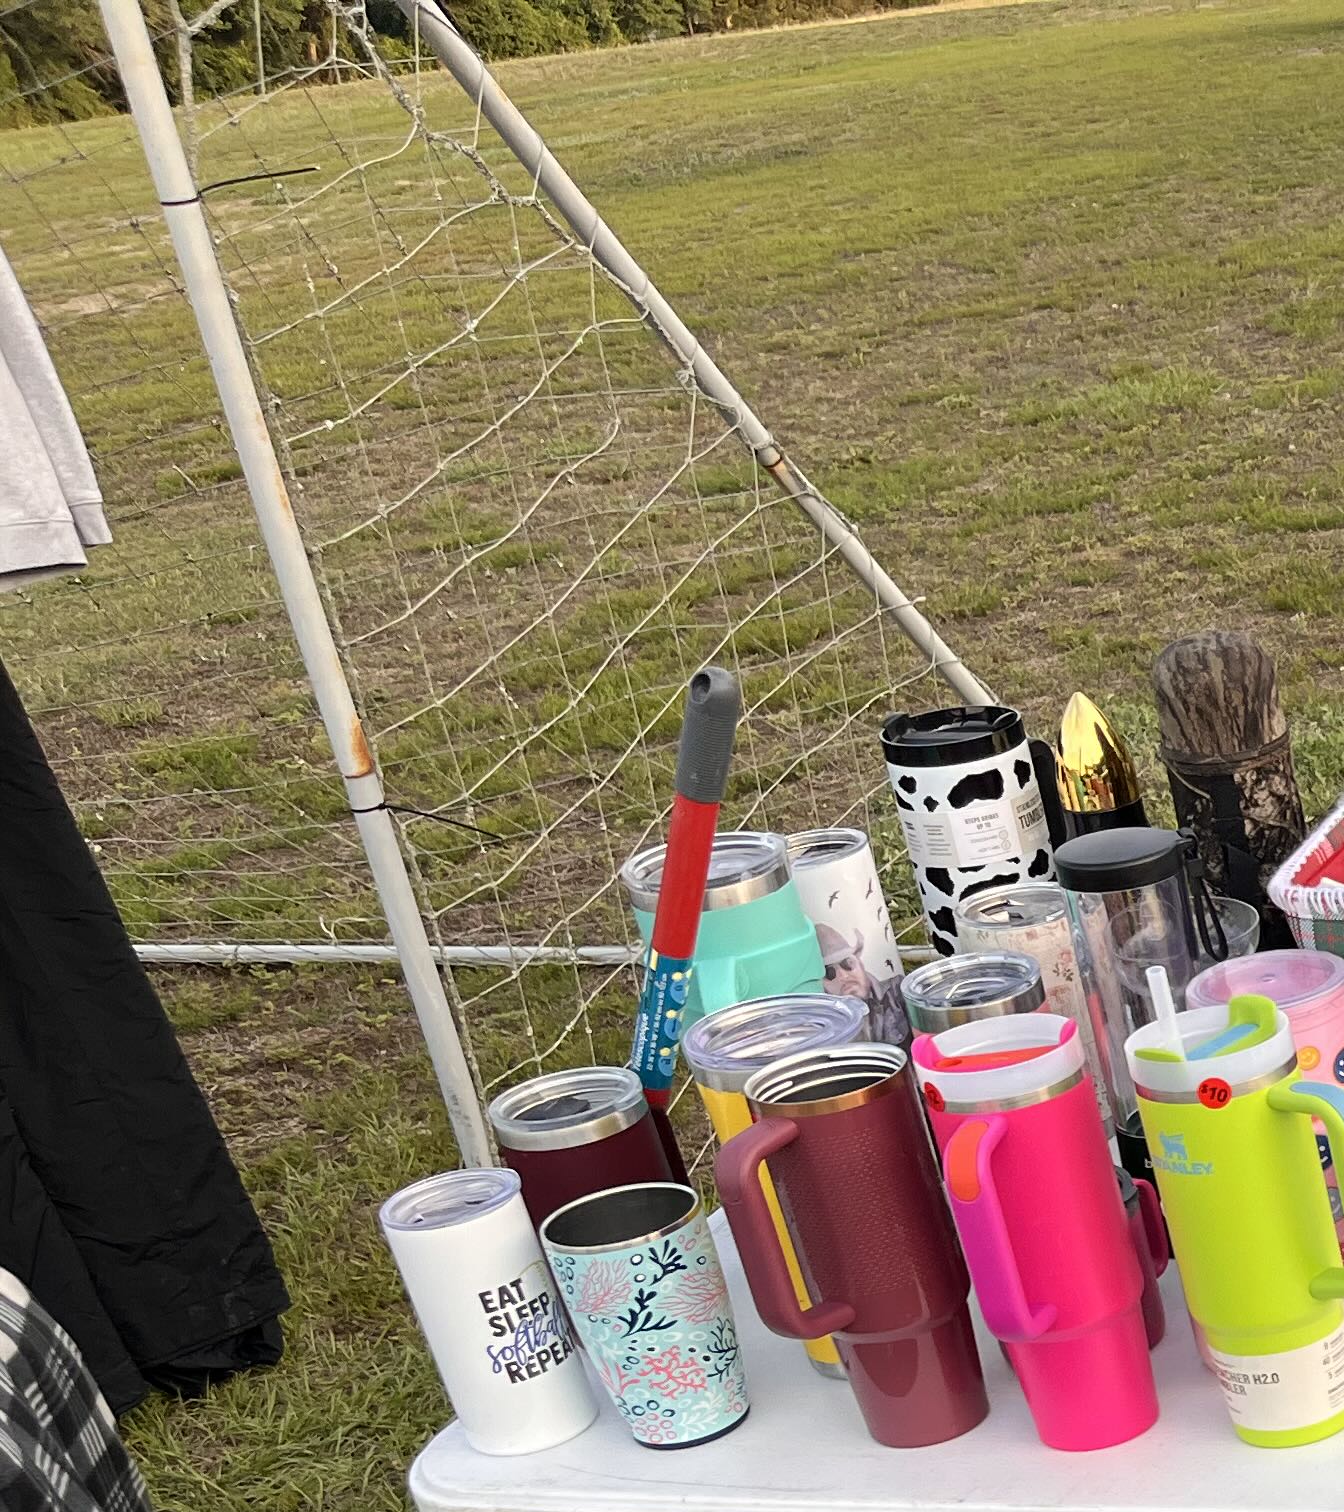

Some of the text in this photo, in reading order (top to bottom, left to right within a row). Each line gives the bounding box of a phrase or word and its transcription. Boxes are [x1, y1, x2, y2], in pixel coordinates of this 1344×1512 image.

[1199, 1084, 1229, 1103] $10
[478, 1277, 526, 1314] EAT
[488, 1291, 550, 1338] SLEEP
